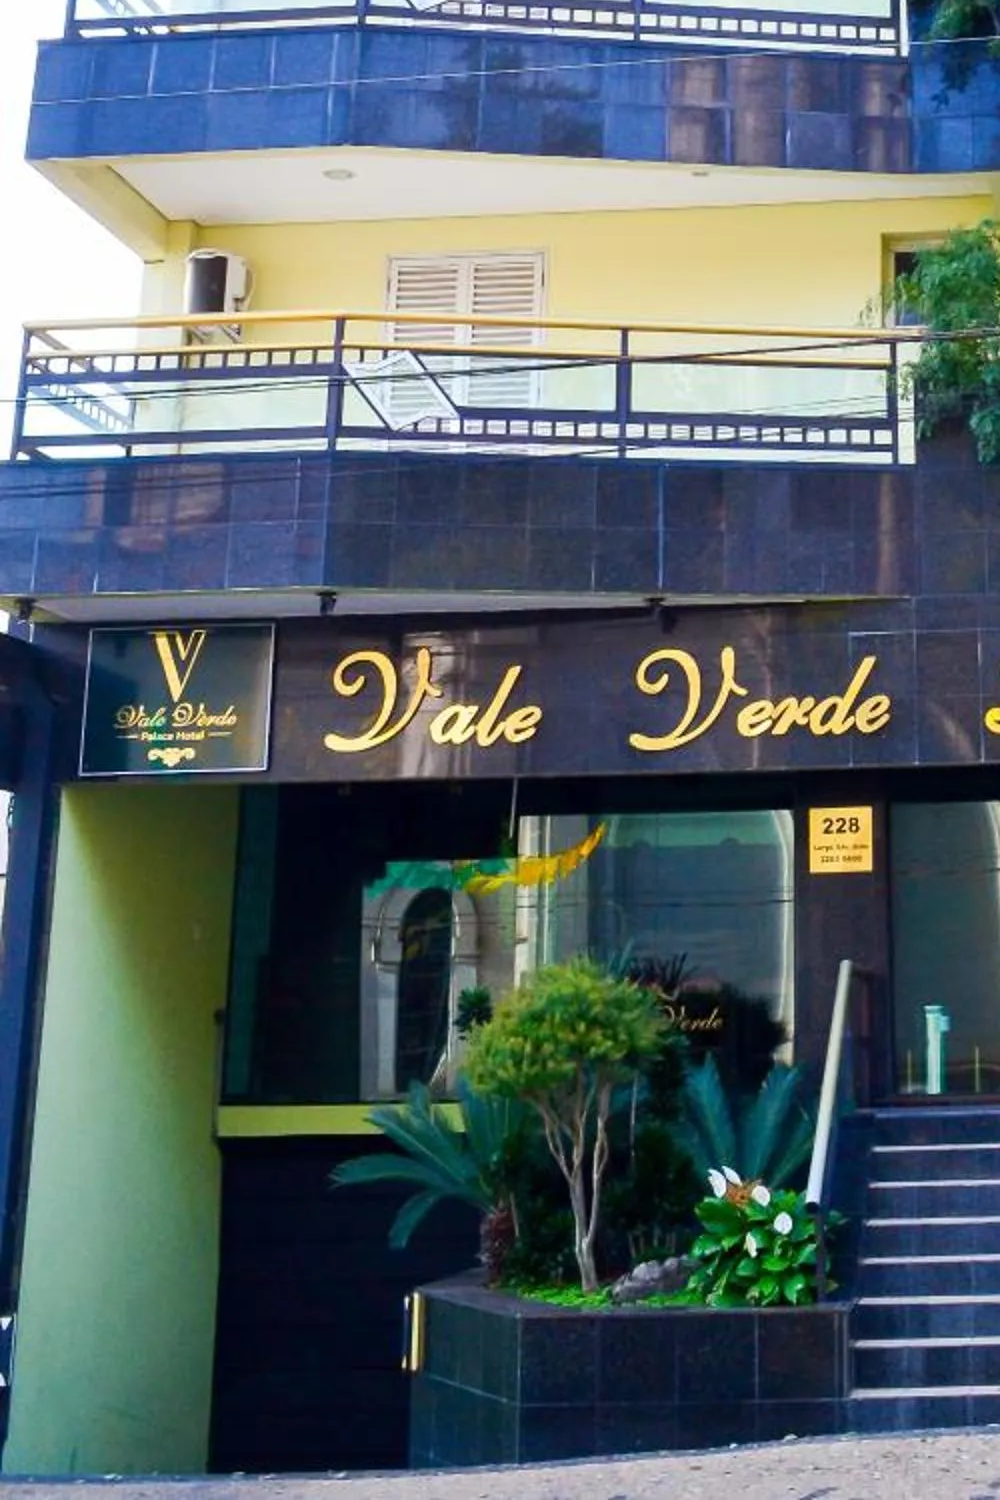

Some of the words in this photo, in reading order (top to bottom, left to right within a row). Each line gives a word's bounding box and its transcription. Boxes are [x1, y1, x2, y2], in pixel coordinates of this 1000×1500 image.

[323, 648, 542, 752] Vale
[628, 646, 890, 752] Verde
[113, 704, 167, 729] Vale
[171, 701, 238, 728] Verde
[822, 816, 861, 835] 228
